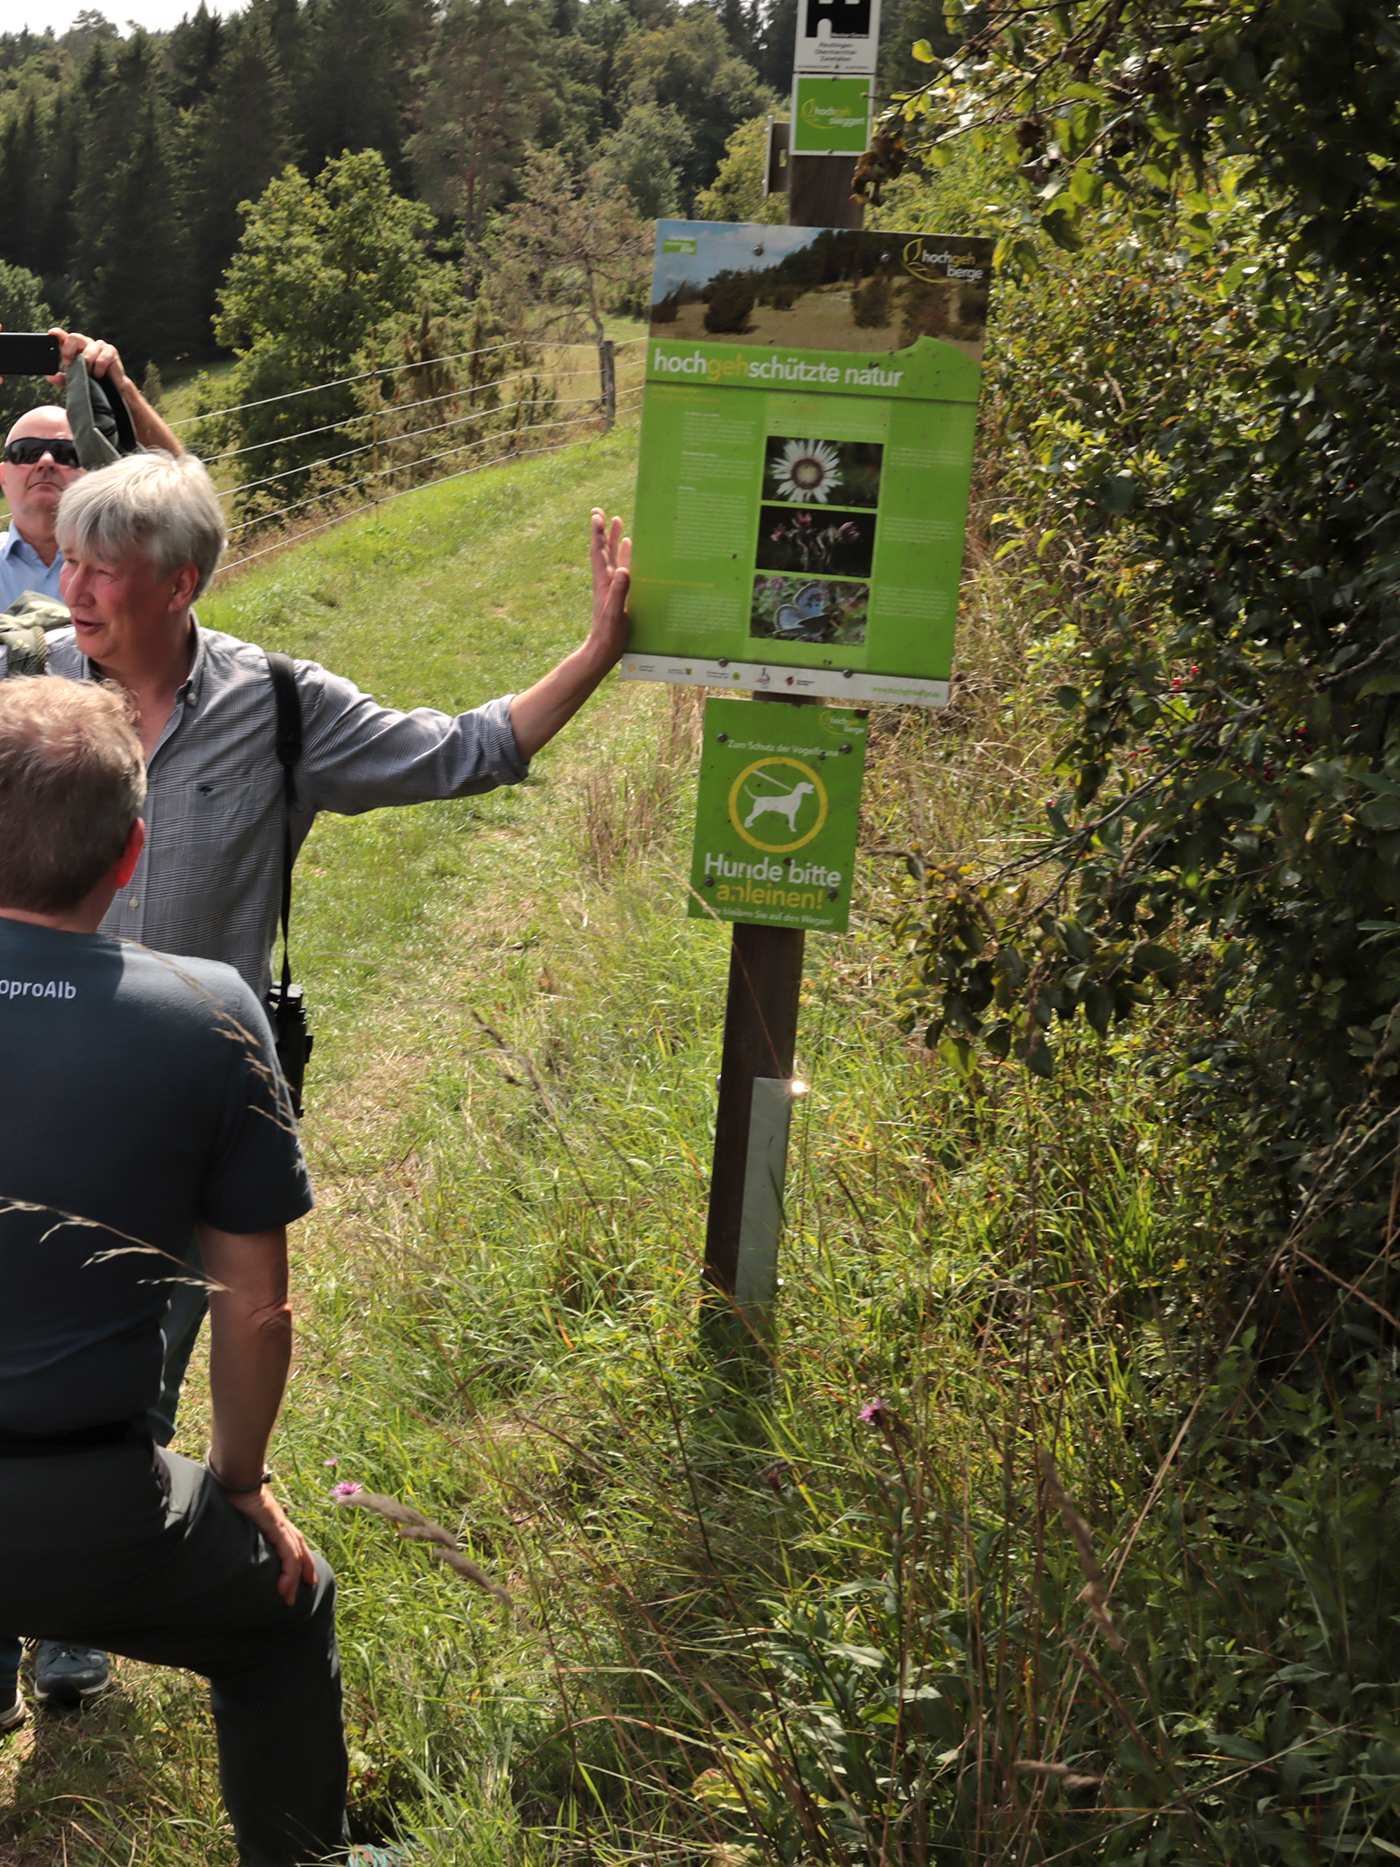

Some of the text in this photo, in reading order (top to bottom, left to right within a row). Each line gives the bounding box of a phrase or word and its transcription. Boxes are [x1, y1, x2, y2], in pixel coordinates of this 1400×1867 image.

[922, 249, 976, 268] hochgeh
[946, 264, 984, 282] berge
[653, 347, 904, 388] hochgehschützte natur
[727, 739, 747, 749] Zum
[747, 741, 775, 752] Schutz
[776, 743, 791, 753] der
[704, 852, 842, 888] Hunde bitte
[716, 879, 823, 910] anleinen!
[722, 907, 754, 918] bleiben
[754, 910, 768, 920] Sie
[768, 911, 784, 921] auf
[784, 913, 800, 923] den
[801, 915, 834, 927] Wegen!
